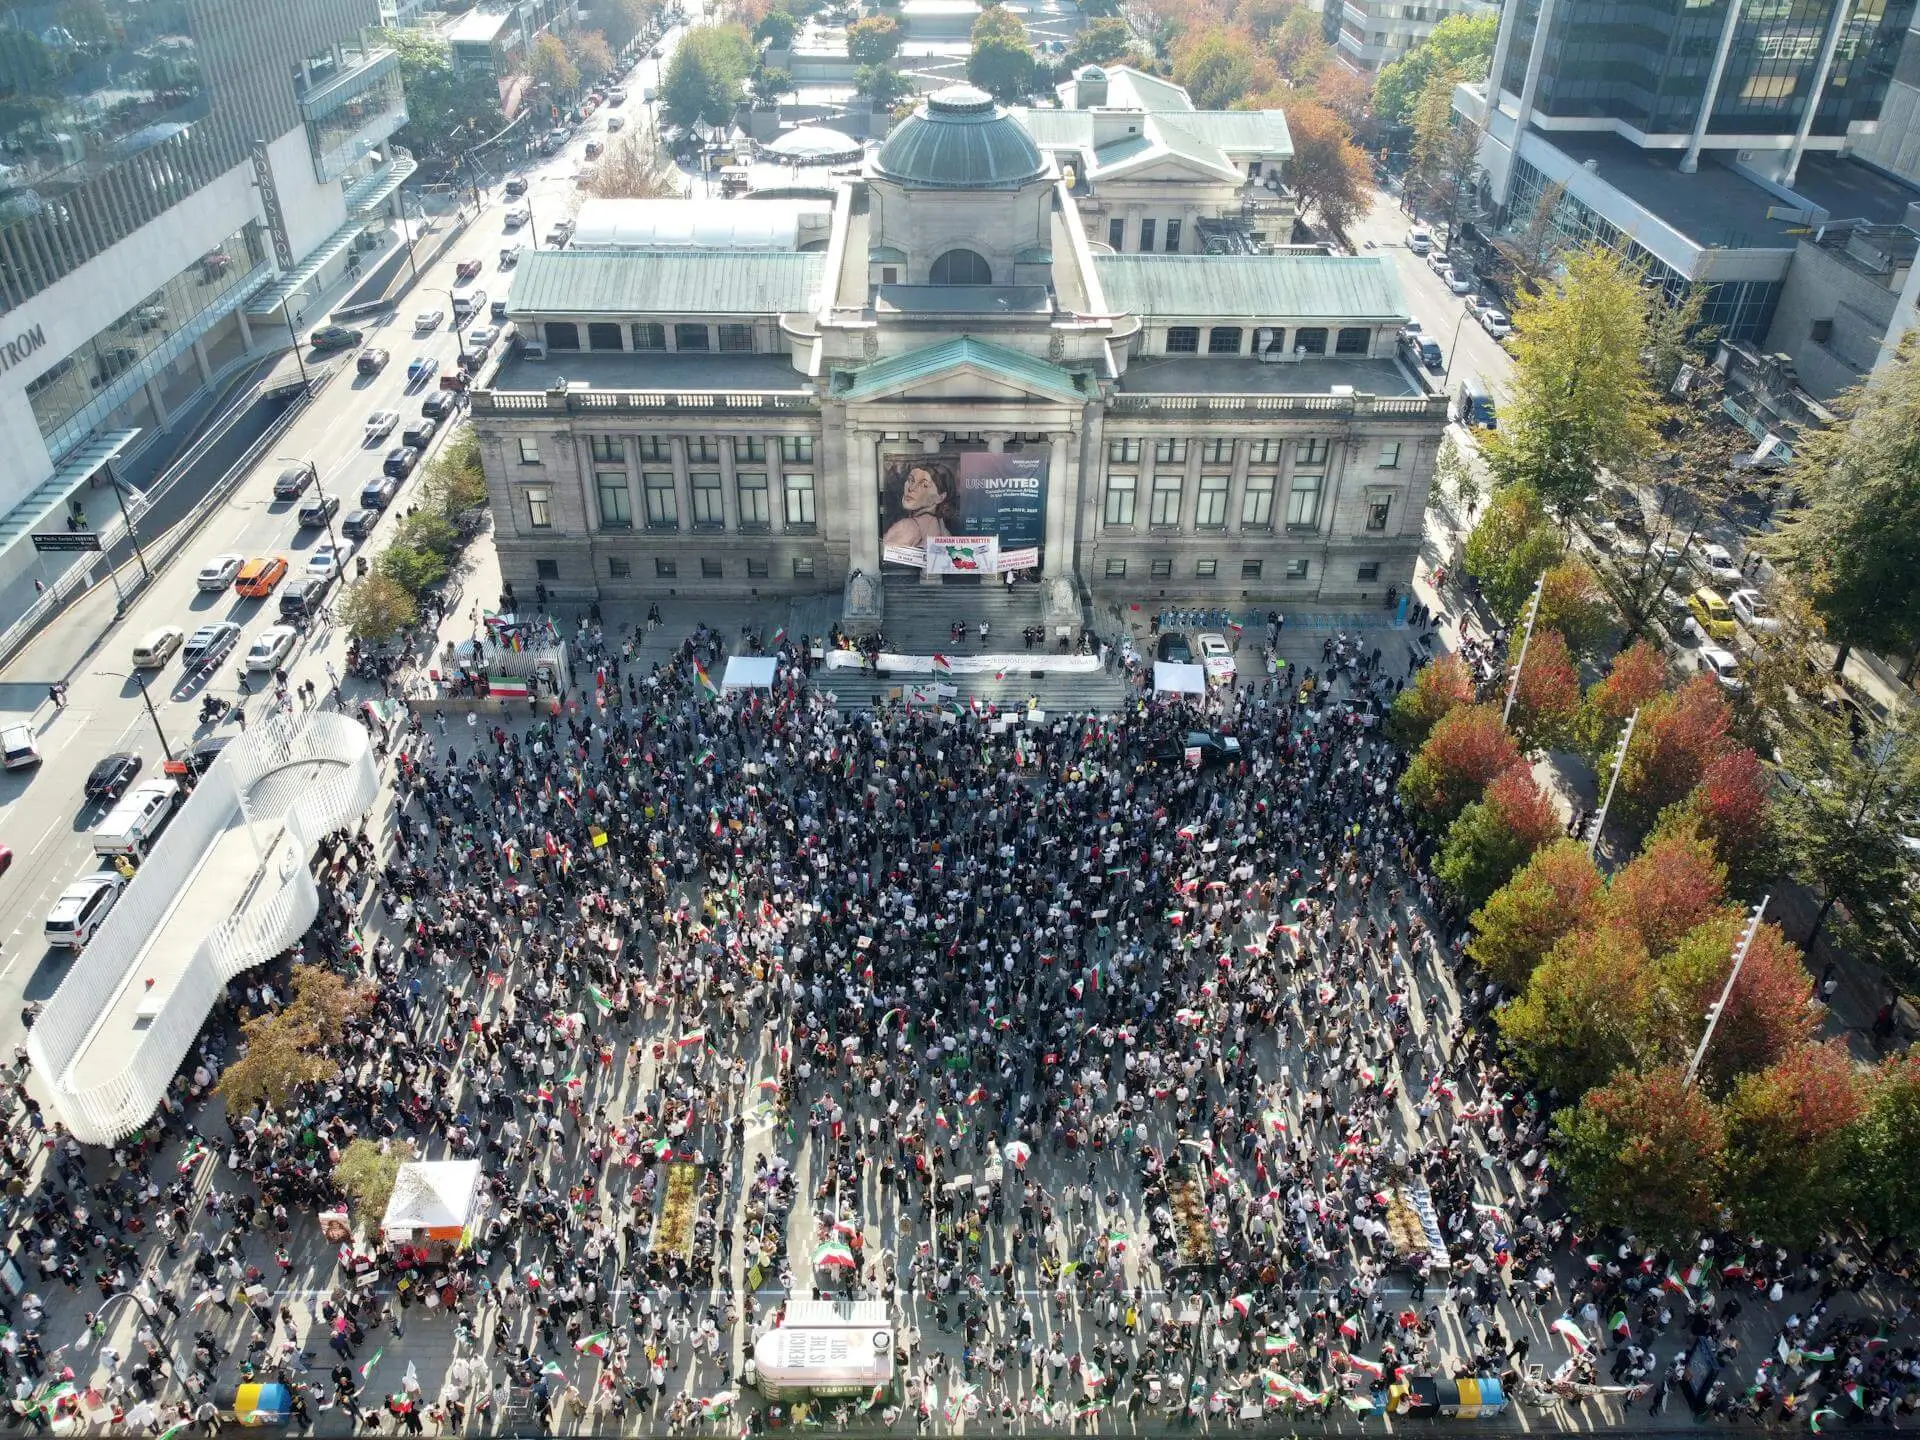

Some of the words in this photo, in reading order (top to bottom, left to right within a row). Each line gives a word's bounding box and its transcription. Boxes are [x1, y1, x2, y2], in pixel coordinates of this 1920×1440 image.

[252, 146, 291, 268] NORDSTROM
[0, 322, 47, 377] TROM
[965, 477, 1039, 489] UNINVITED
[788, 1333, 806, 1368] MEXICO
[810, 1335, 828, 1352] THE
[830, 1339, 848, 1360] SHIT
[809, 1354, 825, 1364] IS
